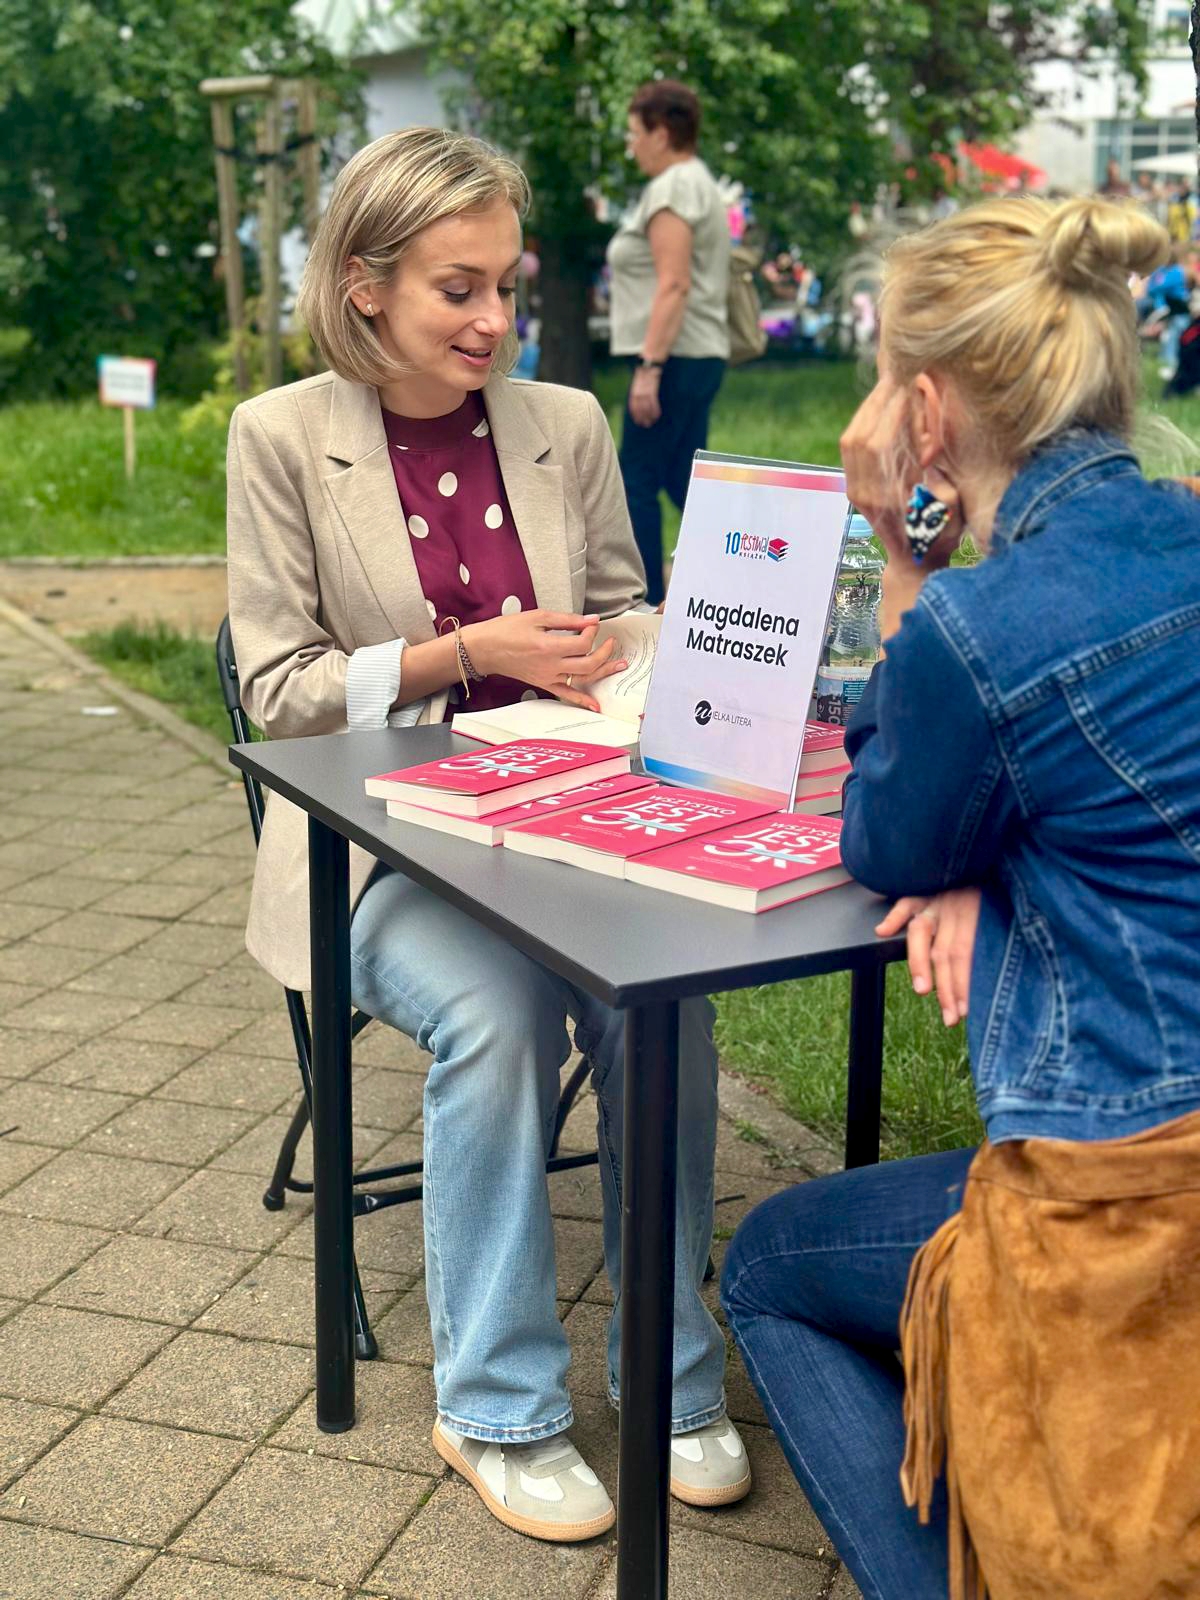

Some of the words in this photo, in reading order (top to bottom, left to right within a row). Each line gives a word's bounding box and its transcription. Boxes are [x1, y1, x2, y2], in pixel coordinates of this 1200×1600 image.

[726, 532, 741, 554] 10
[687, 597, 800, 637] Magdalena
[686, 627, 789, 667] Matraszek
[731, 714, 752, 728] LITERA
[469, 750, 574, 765] JEST
[506, 745, 586, 758] WSZYSTKO
[612, 800, 724, 822] JEST
[649, 795, 737, 815] WSZYSTKO
[733, 828, 840, 853] JEST
